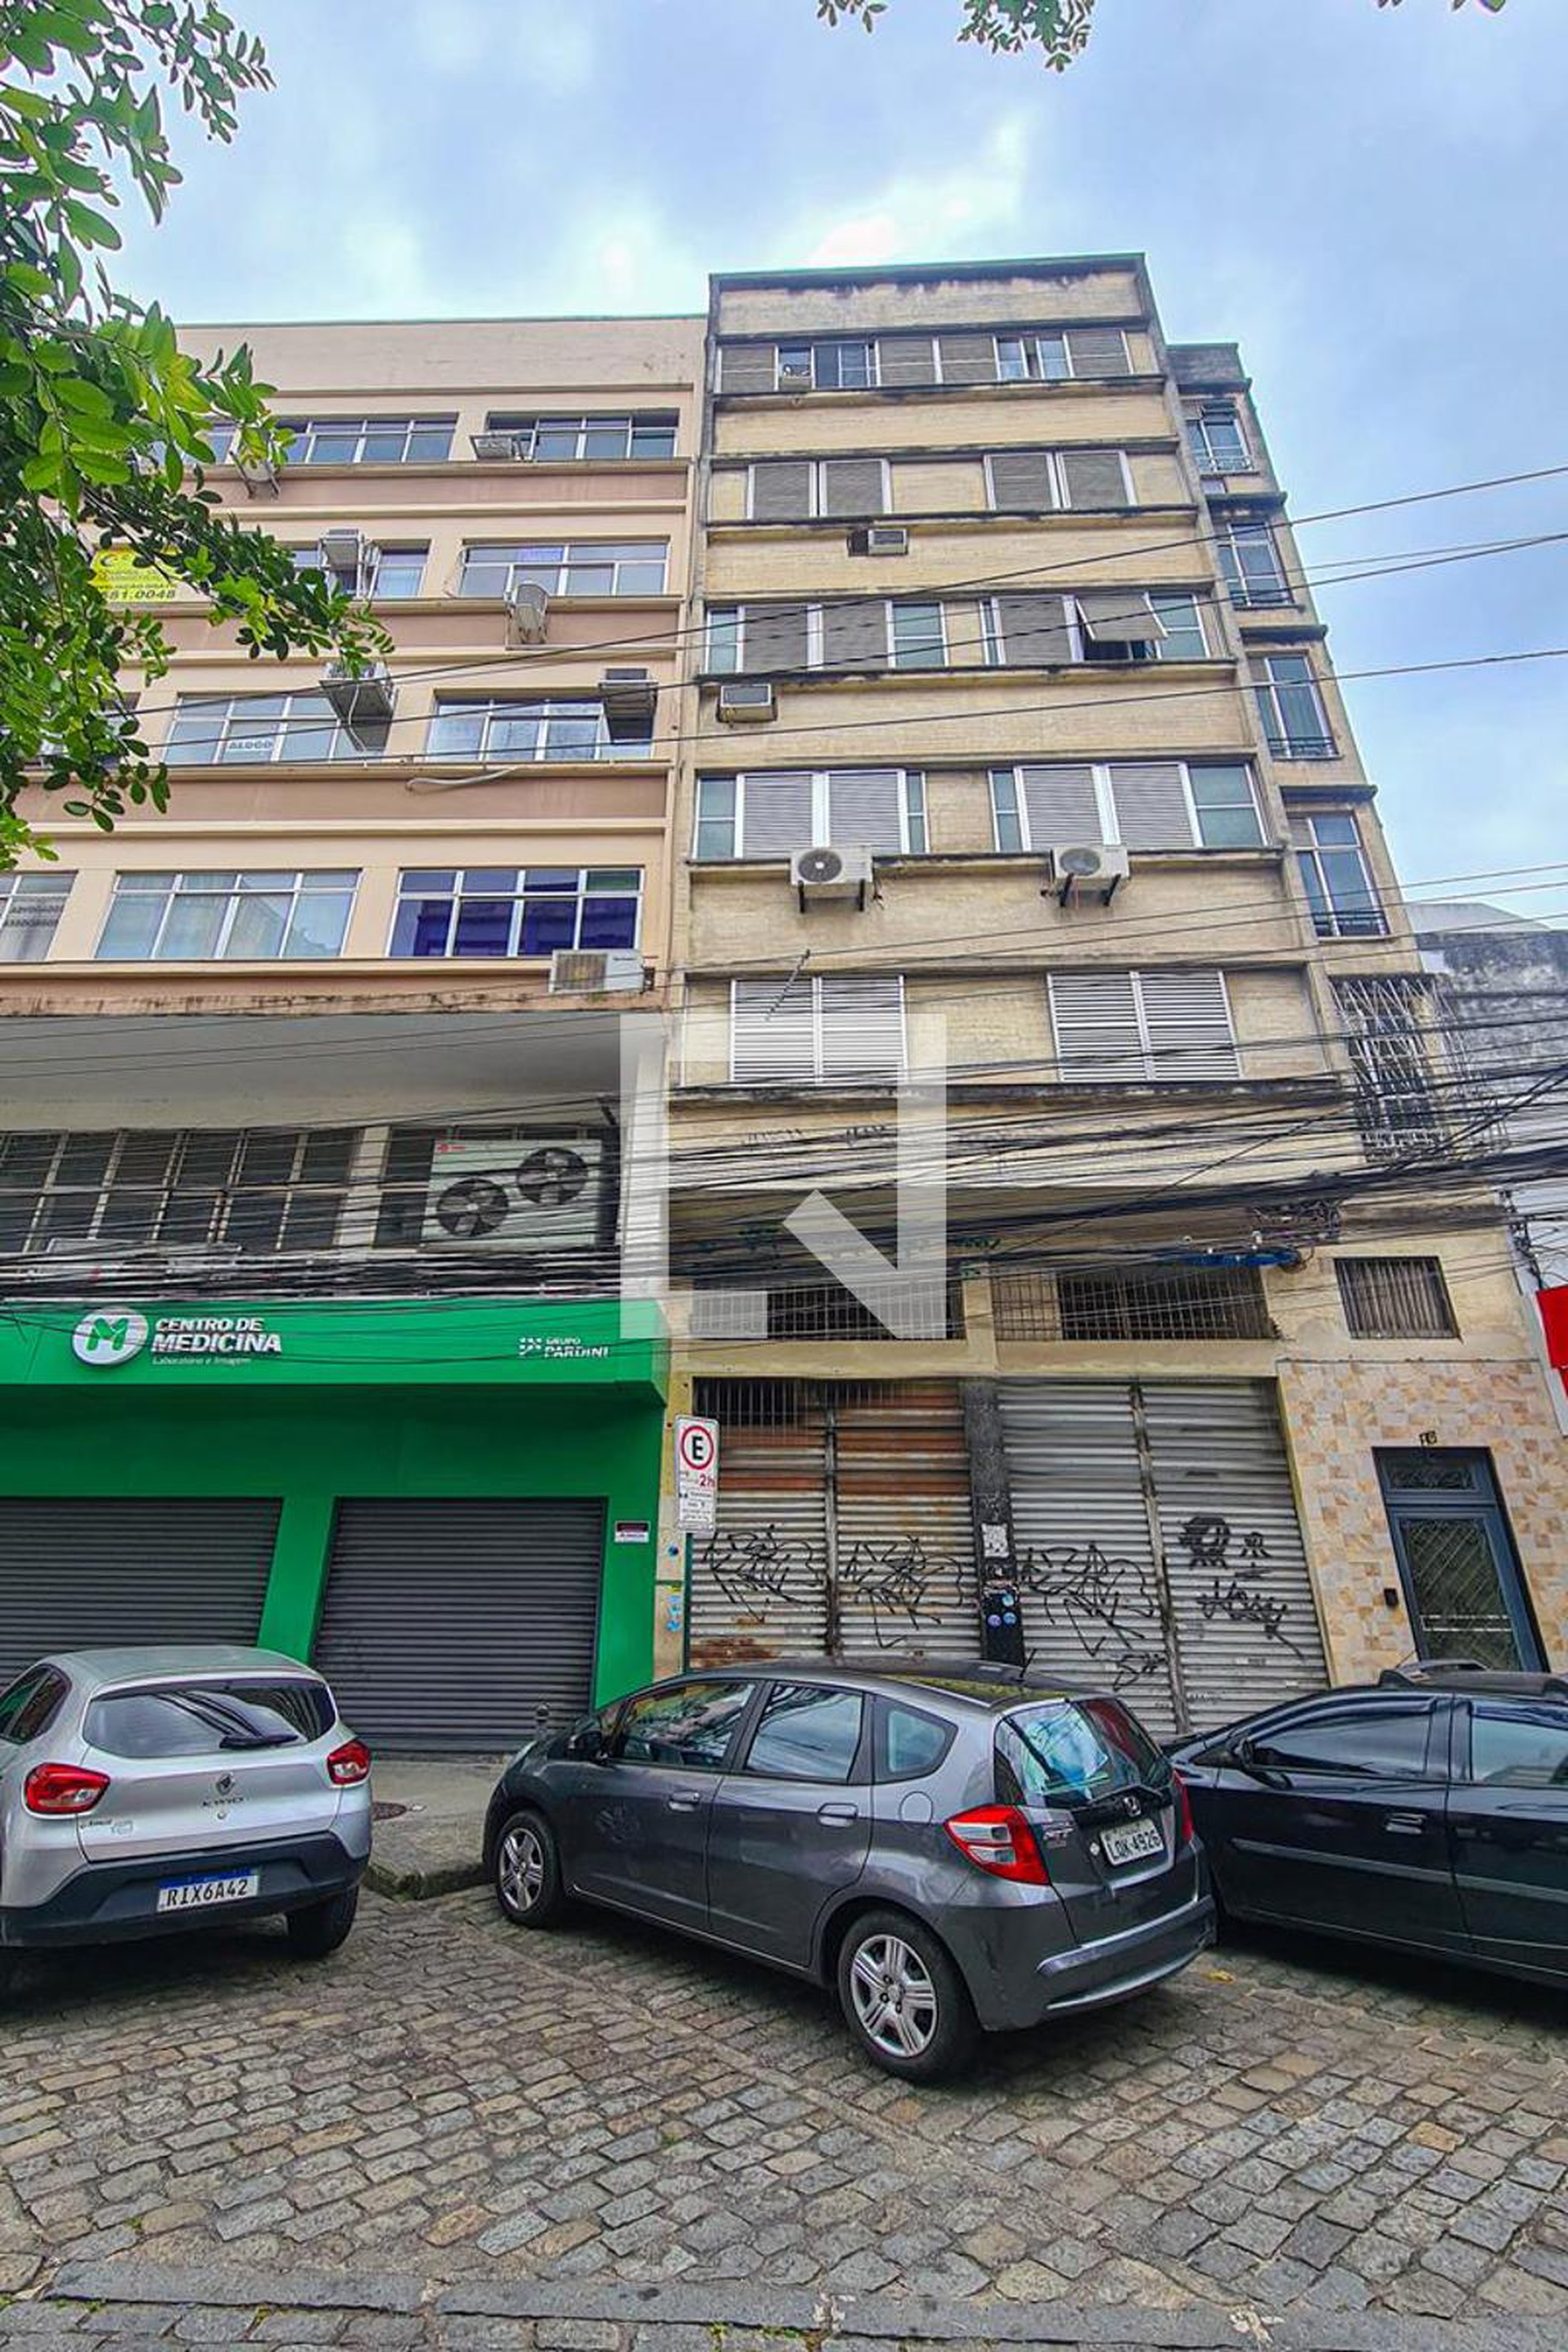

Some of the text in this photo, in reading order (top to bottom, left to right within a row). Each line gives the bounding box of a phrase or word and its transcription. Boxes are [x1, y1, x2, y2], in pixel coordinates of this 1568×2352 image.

[156, 1318, 264, 1331] CENTRO DE
[151, 1333, 282, 1352] MEDICINA
[693, 1437, 703, 1459] E
[167, 1879, 247, 1906] RIX6A42
